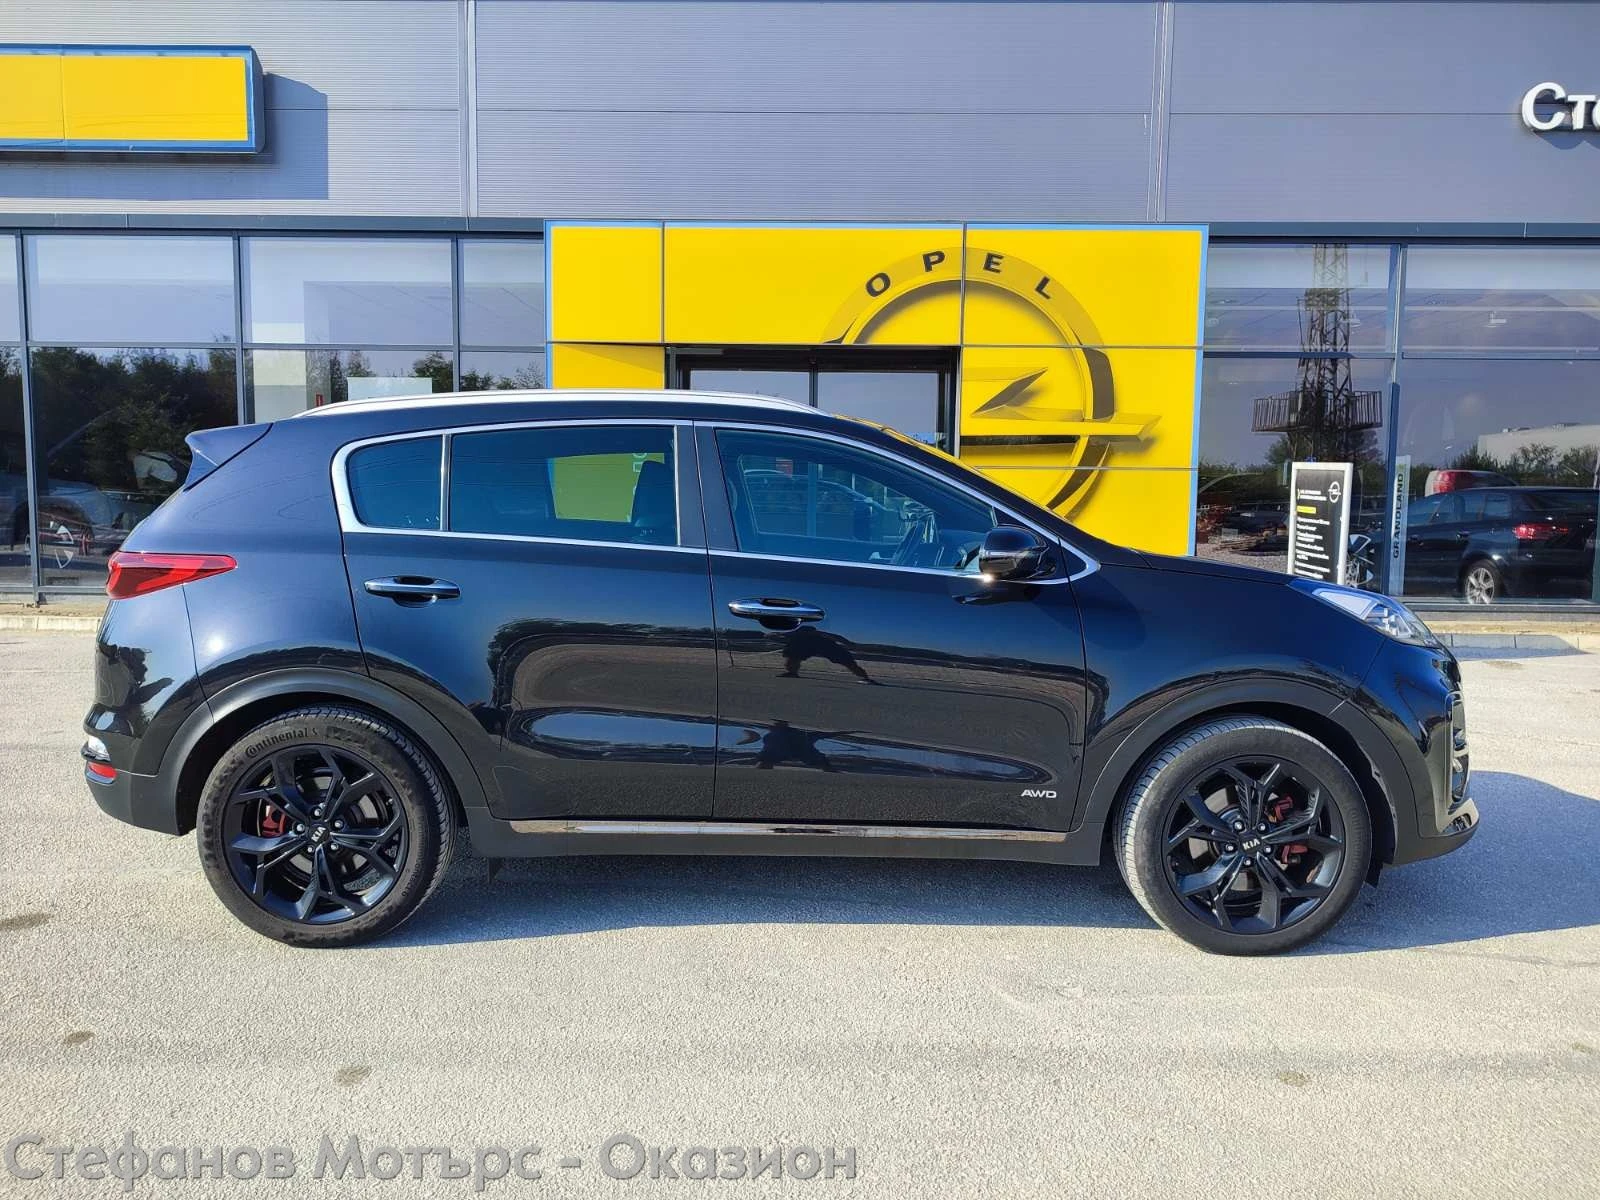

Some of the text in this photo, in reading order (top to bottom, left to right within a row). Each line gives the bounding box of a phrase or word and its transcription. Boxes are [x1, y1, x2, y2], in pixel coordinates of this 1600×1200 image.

[865, 250, 1052, 299] OPEL
[1392, 473, 1404, 559] GRANDLAND
[244, 726, 308, 758] Continental
[1020, 789, 1057, 799] AWD
[311, 826, 327, 842] KIA
[1242, 838, 1260, 850] KIA
